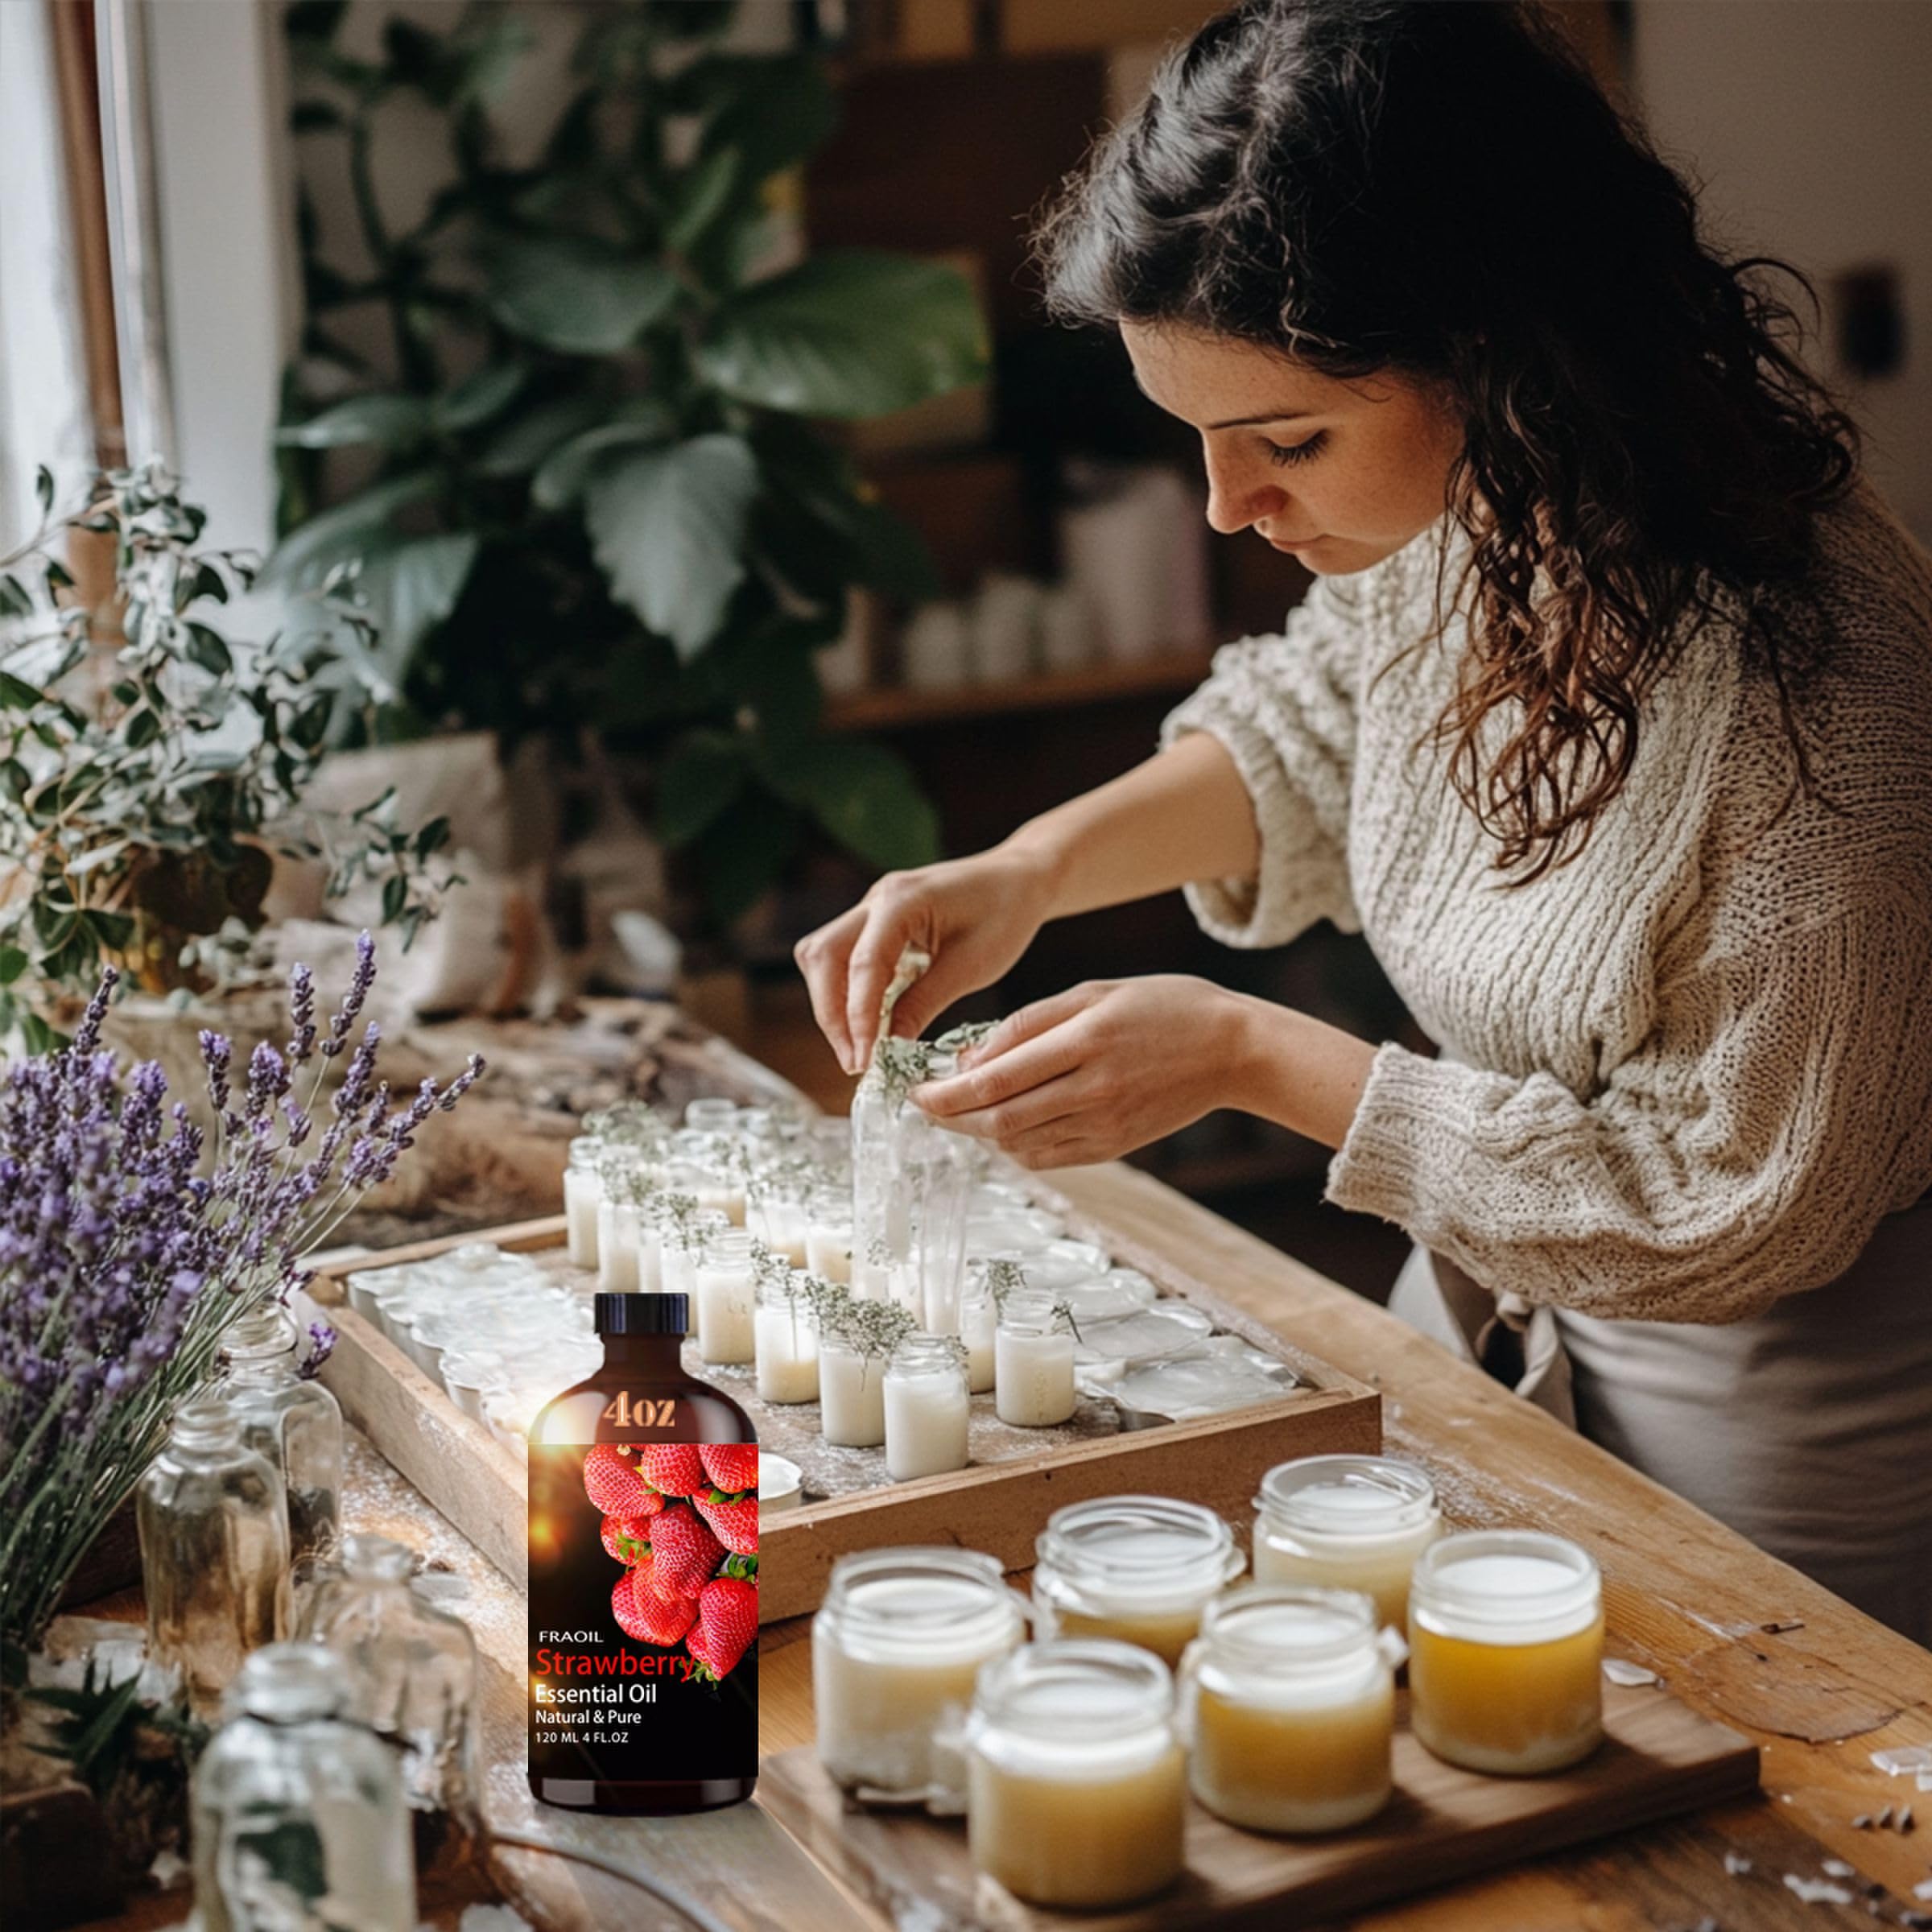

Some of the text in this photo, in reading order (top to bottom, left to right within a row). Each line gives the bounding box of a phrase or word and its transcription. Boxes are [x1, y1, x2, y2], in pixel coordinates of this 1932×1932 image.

[604, 1390, 675, 1427] 4oz
[539, 1630, 604, 1643] FRAOIL
[535, 1648, 696, 1682] Strawberry
[535, 1683, 657, 1703] Essential Oil
[535, 1709, 642, 1724] Natural & Pure
[535, 1732, 629, 1743] 120 ML 4 FL.OZ
